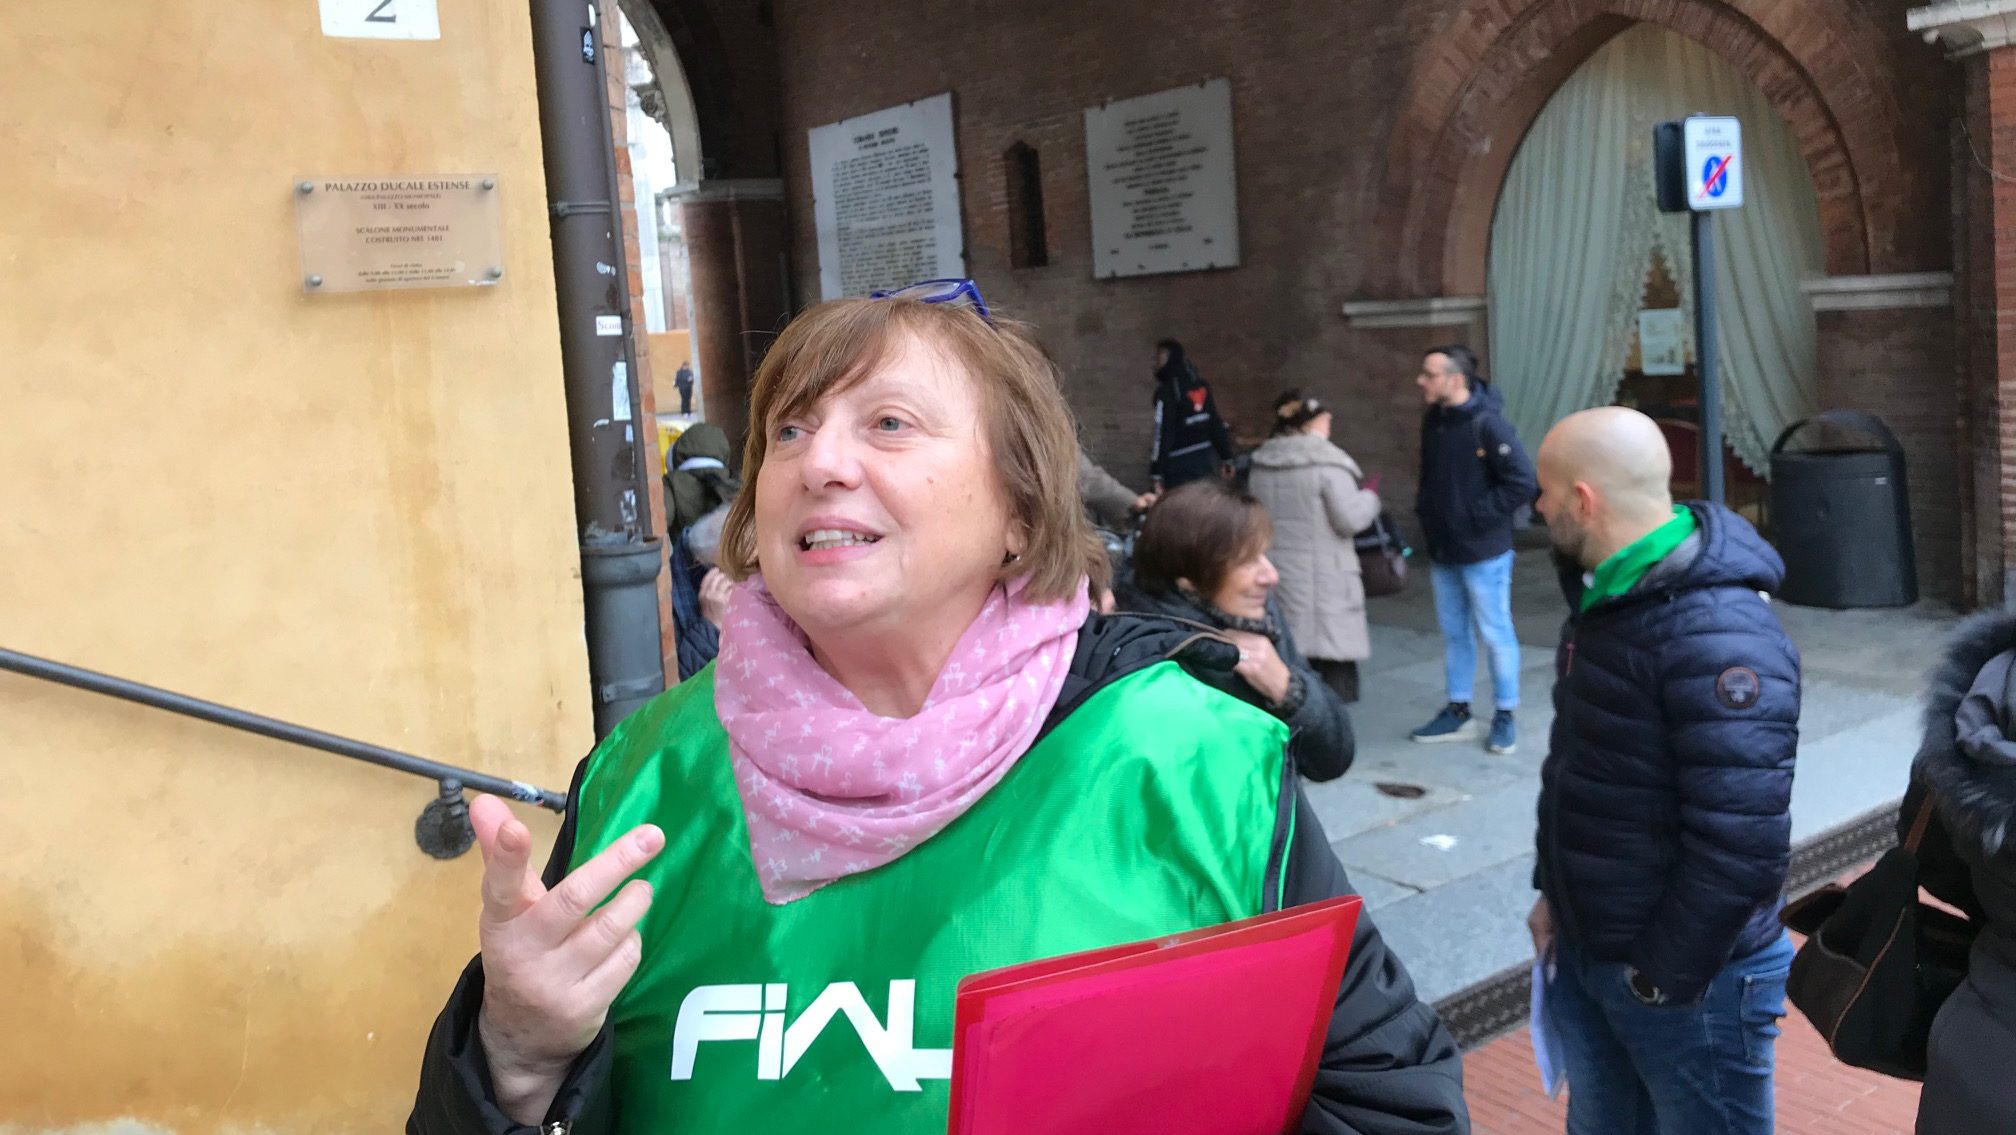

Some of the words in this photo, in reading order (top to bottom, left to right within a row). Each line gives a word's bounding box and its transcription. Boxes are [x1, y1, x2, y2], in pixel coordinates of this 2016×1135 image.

[325, 182, 377, 192] PALAZZO
[380, 181, 424, 191] DUCALE
[427, 180, 470, 190] ESTENSE
